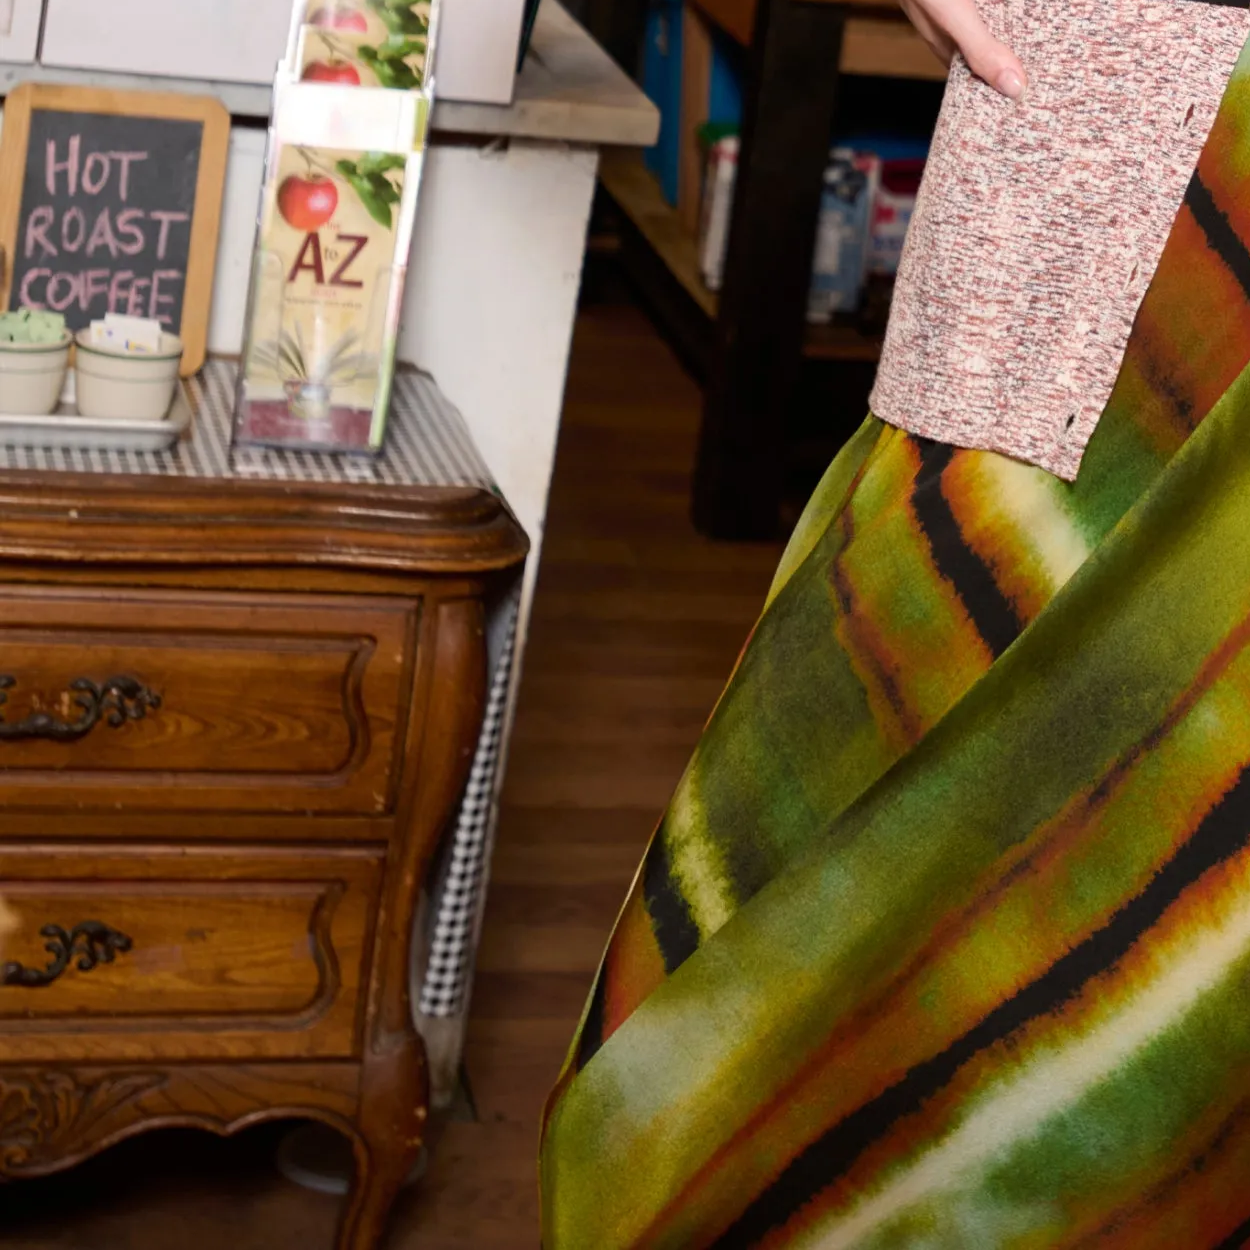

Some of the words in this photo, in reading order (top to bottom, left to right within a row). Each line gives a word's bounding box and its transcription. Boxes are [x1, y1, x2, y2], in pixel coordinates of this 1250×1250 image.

[46, 134, 148, 201] HOT
[24, 205, 189, 261] ROAST
[287, 230, 325, 285] A
[324, 247, 339, 262] to
[328, 233, 369, 289] Z
[19, 267, 182, 325] COFFEE
